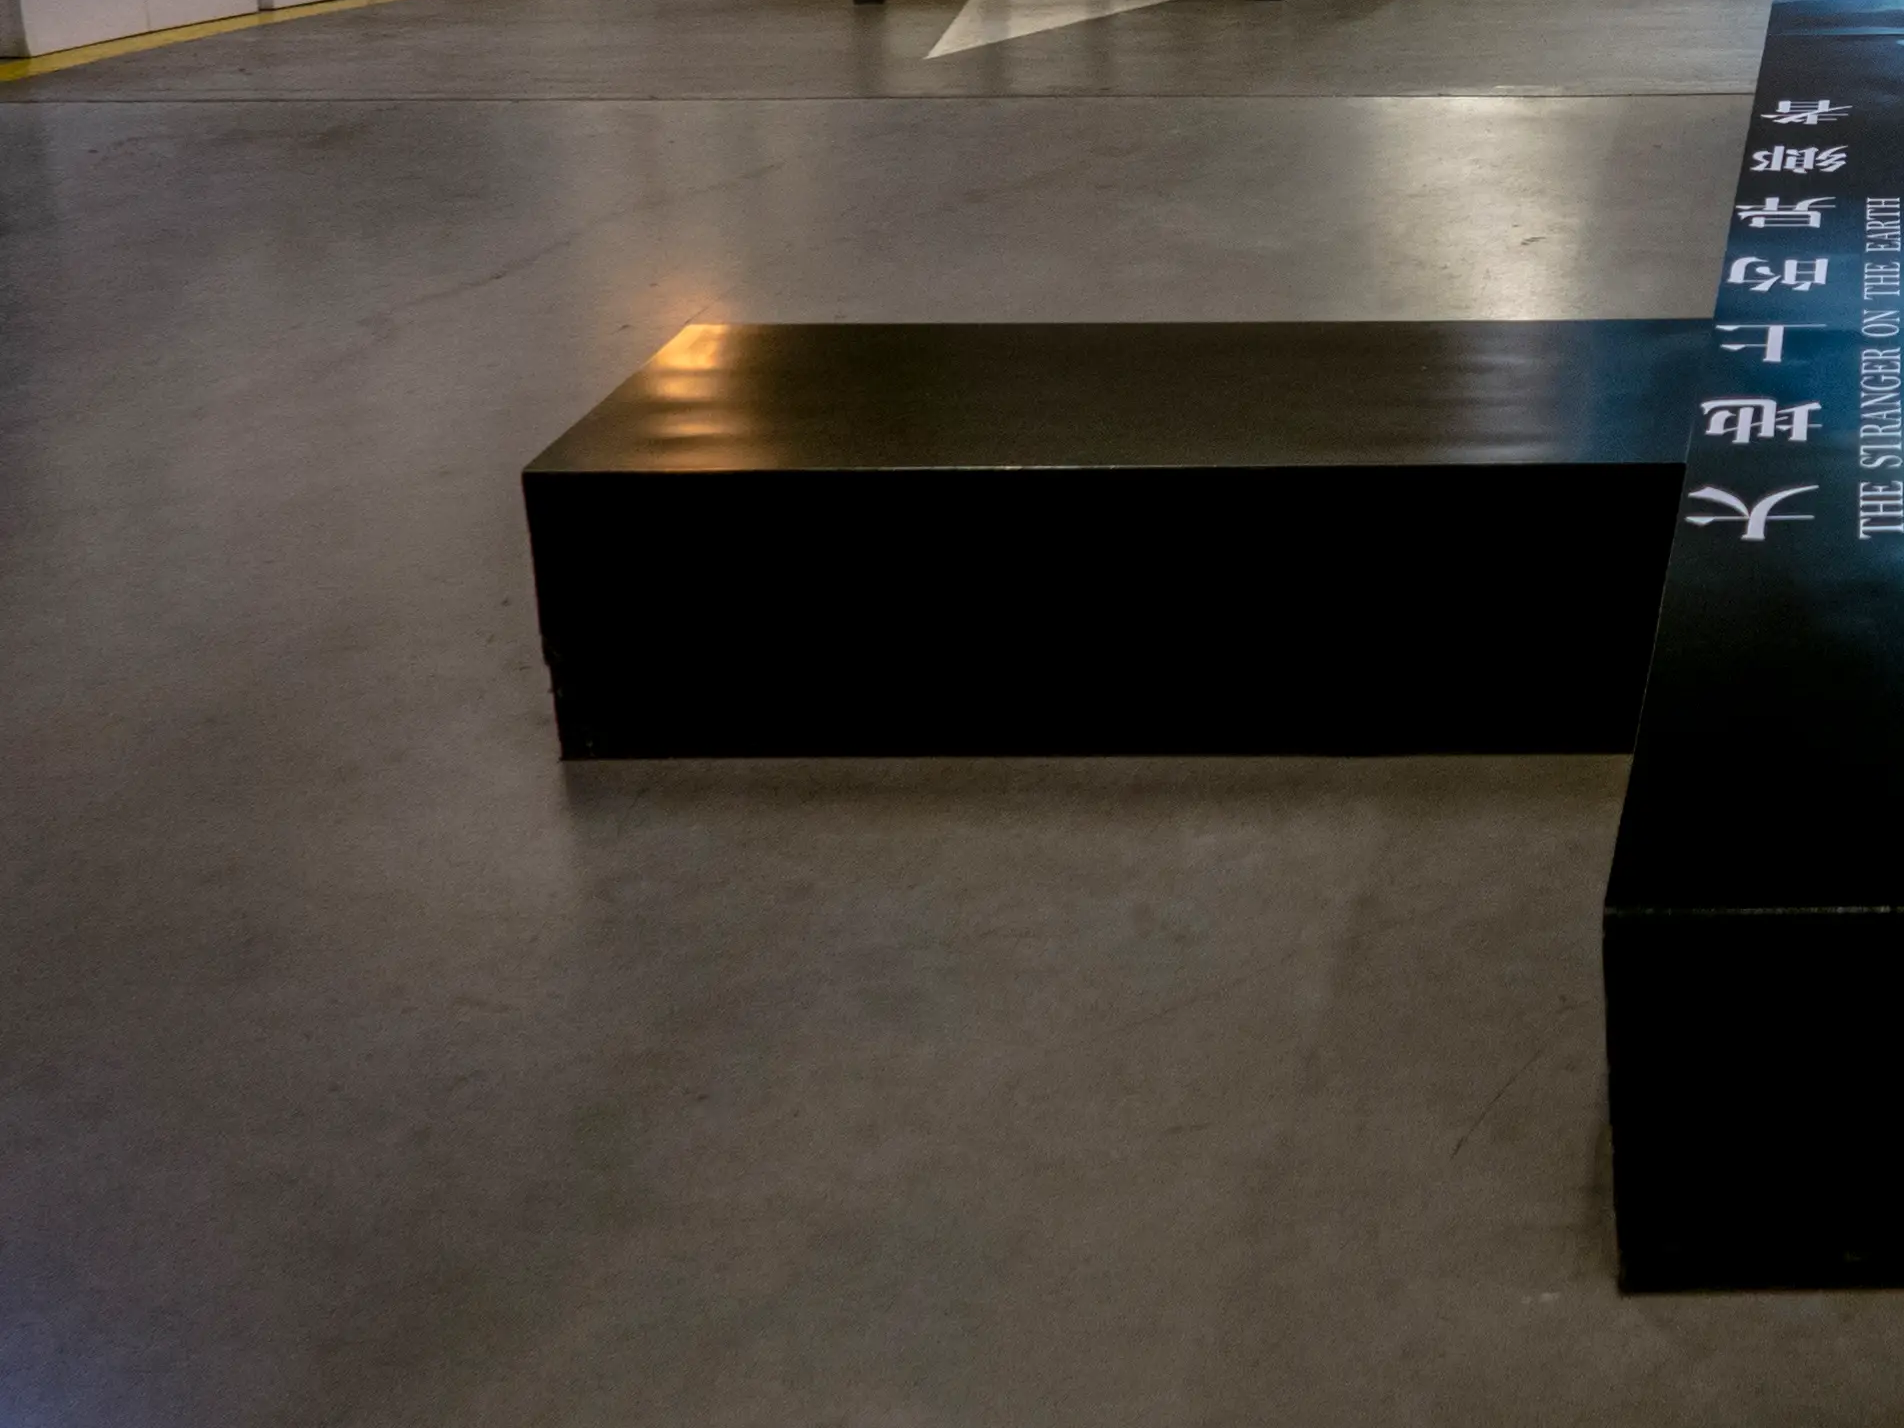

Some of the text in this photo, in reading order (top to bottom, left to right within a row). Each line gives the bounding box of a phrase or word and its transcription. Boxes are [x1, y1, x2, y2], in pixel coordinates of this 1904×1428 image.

[1858, 196, 1904, 540] THE STRANGER ON THE EARTH
